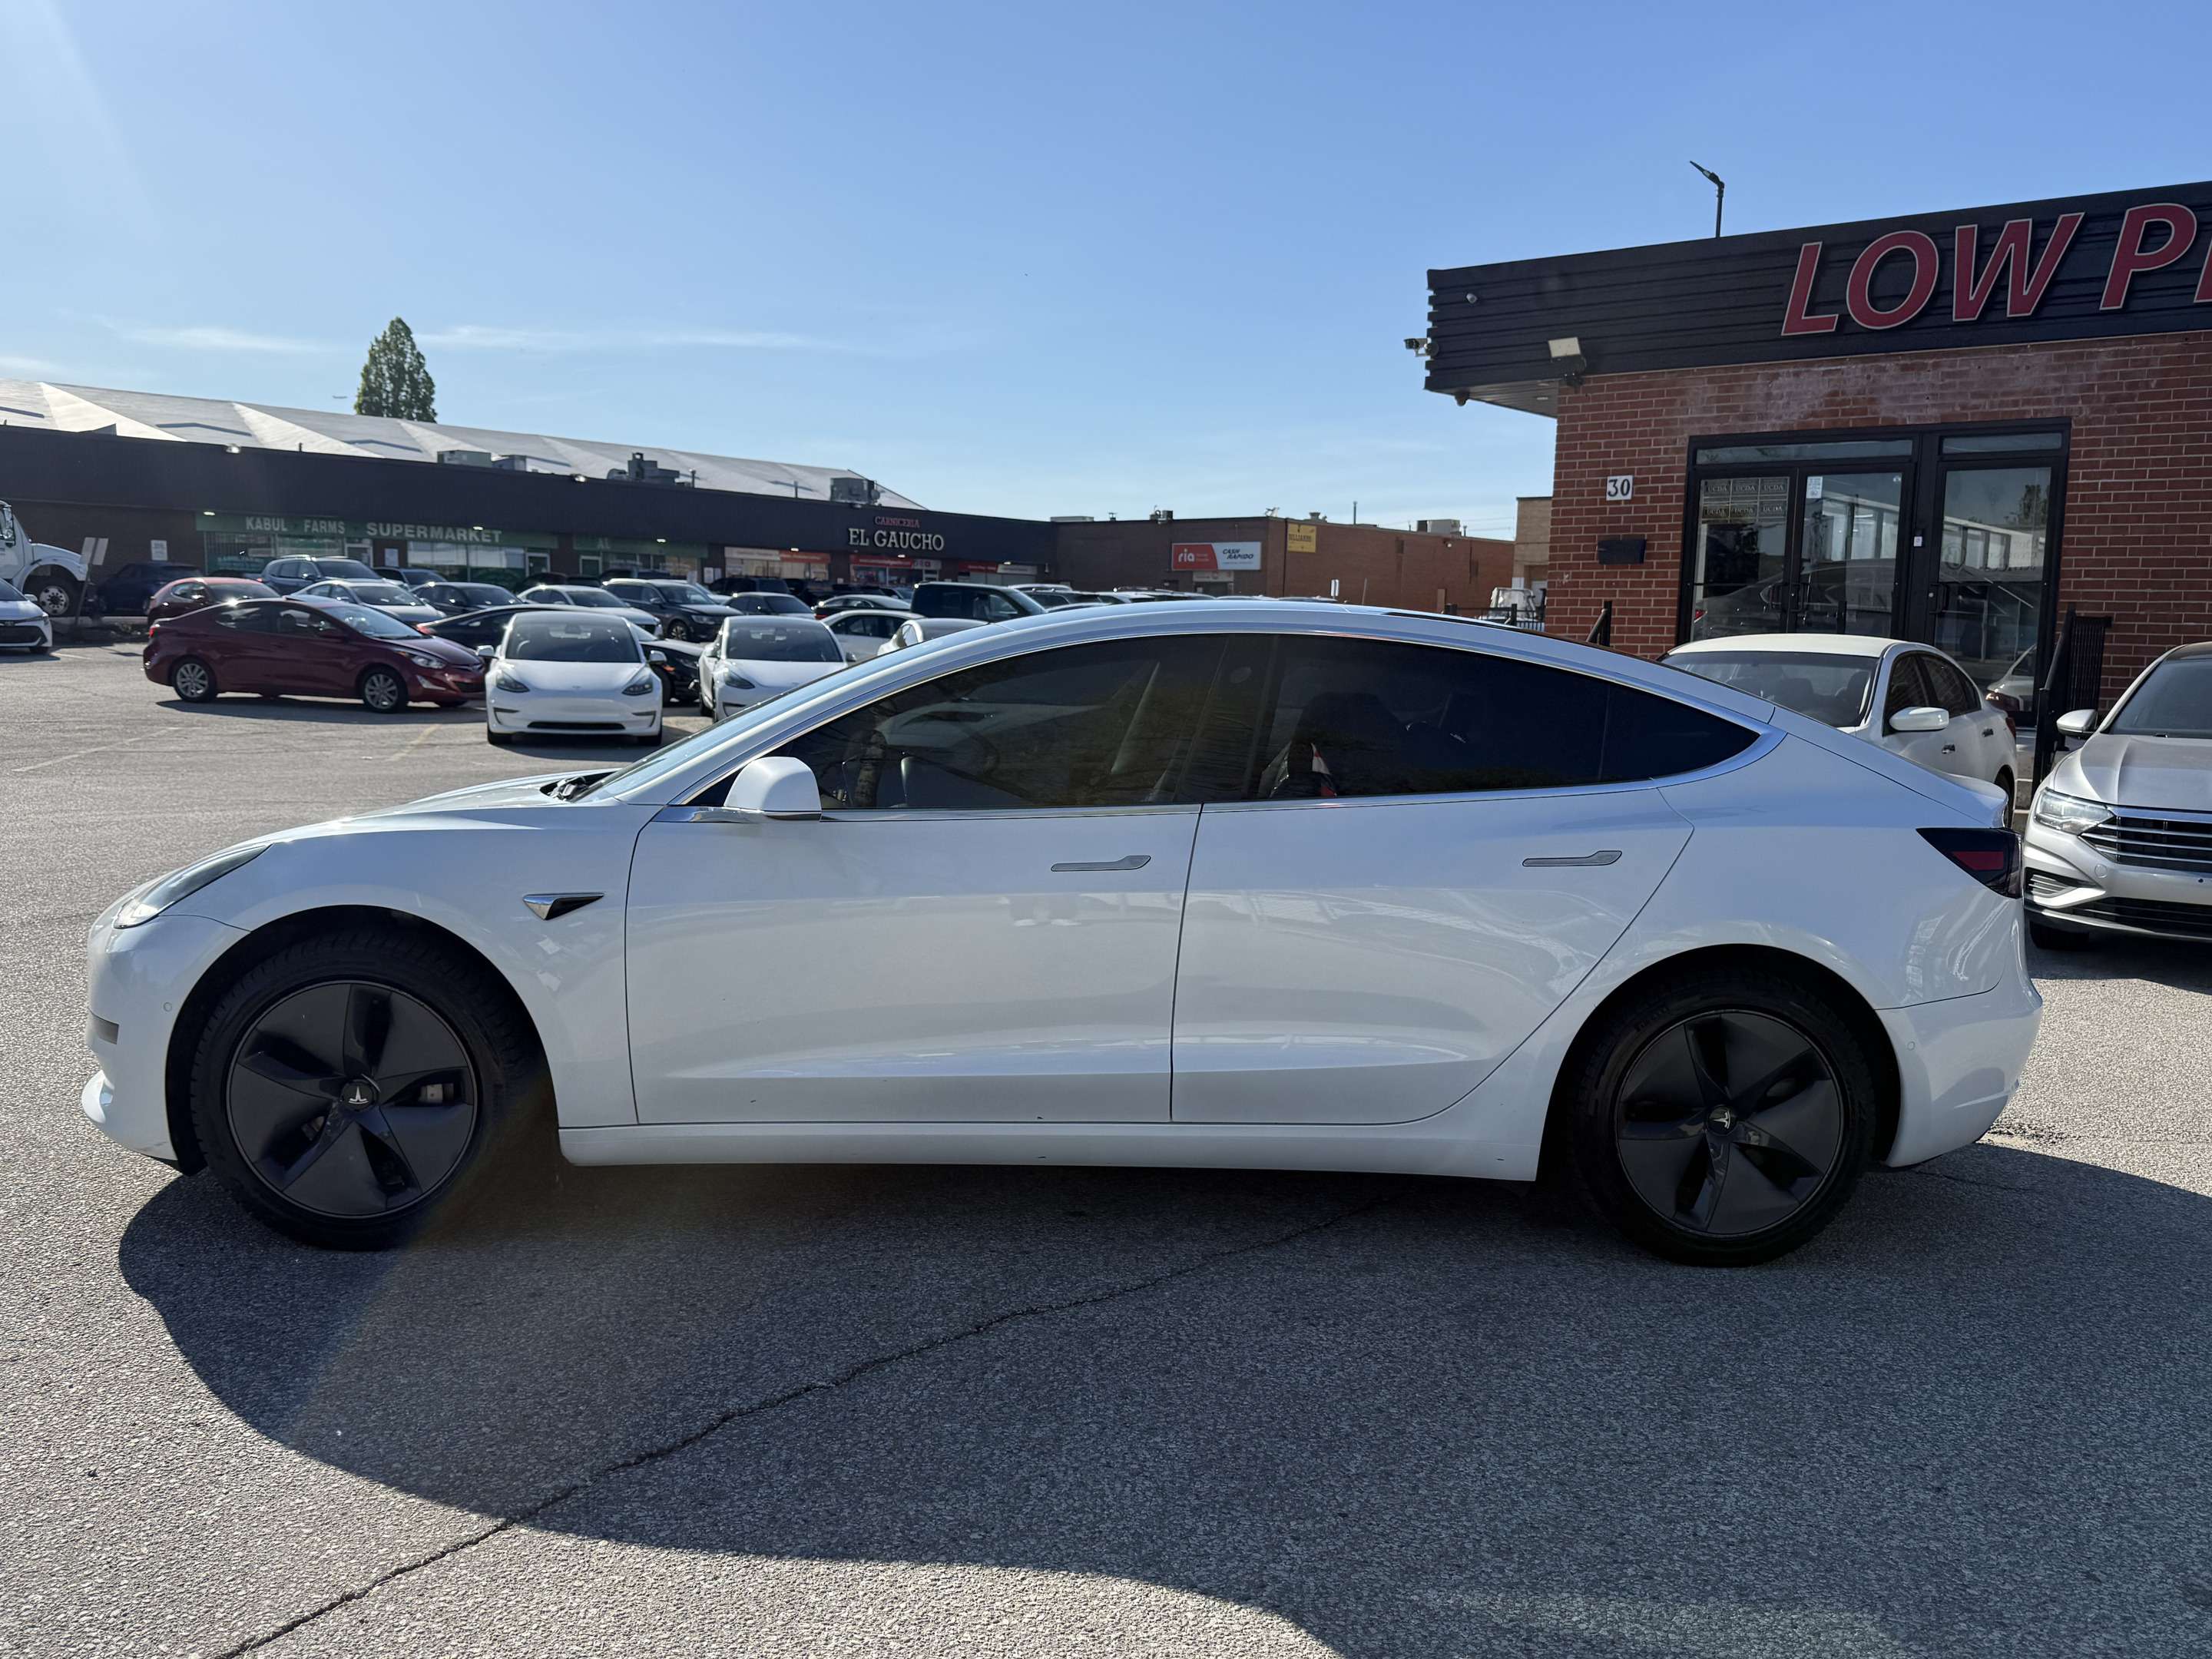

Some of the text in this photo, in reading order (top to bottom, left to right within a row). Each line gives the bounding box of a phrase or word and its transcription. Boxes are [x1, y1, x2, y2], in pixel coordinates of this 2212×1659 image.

[1781, 202, 2212, 336] LOW P
[1608, 478, 1631, 497] 30
[1763, 483, 1783, 492] UCDA
[246, 515, 502, 543] KABUL FARMS SUPERMARKET
[848, 528, 945, 551] EL GAUCHO
[1177, 548, 1196, 562] ria
